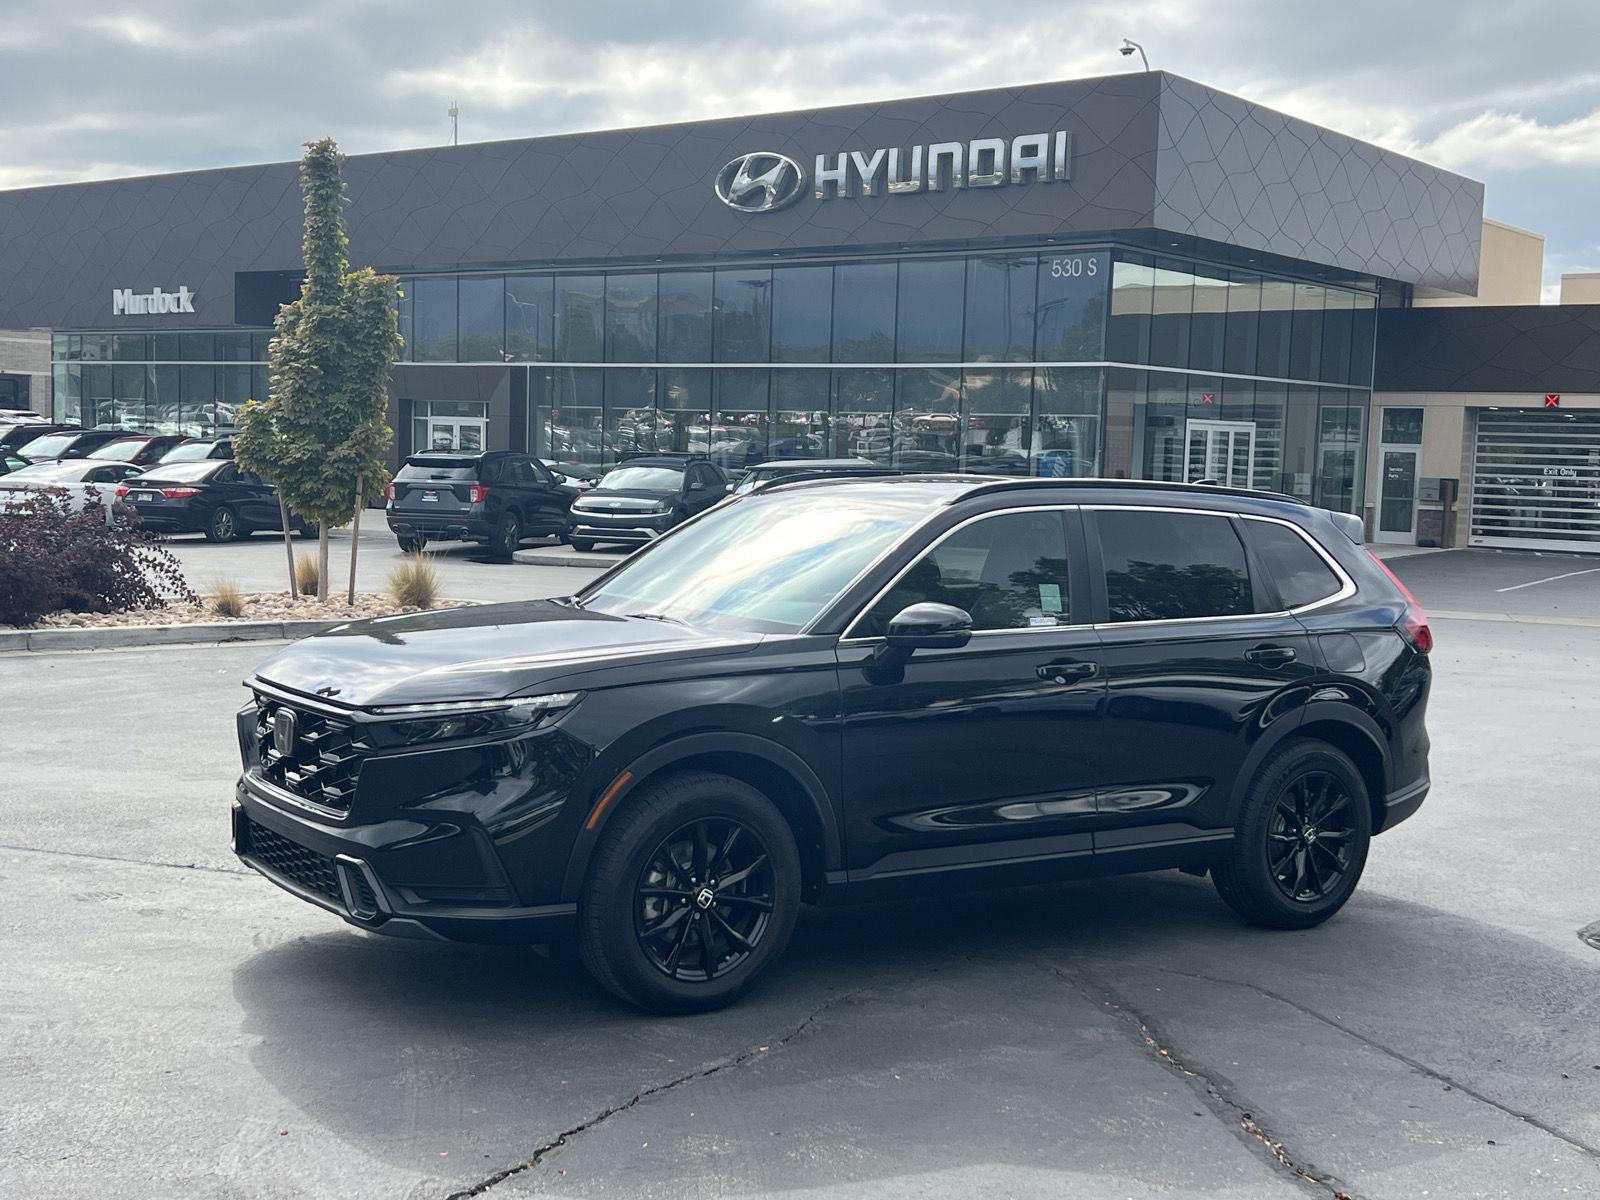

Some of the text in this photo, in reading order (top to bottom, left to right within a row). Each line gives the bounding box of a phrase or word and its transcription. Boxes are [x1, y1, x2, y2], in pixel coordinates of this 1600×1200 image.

[814, 130, 1071, 200] HYUNDAI
[1051, 257, 1098, 278] 530 S
[113, 285, 196, 316] Murdock
[1543, 466, 1578, 478] Exit Only
